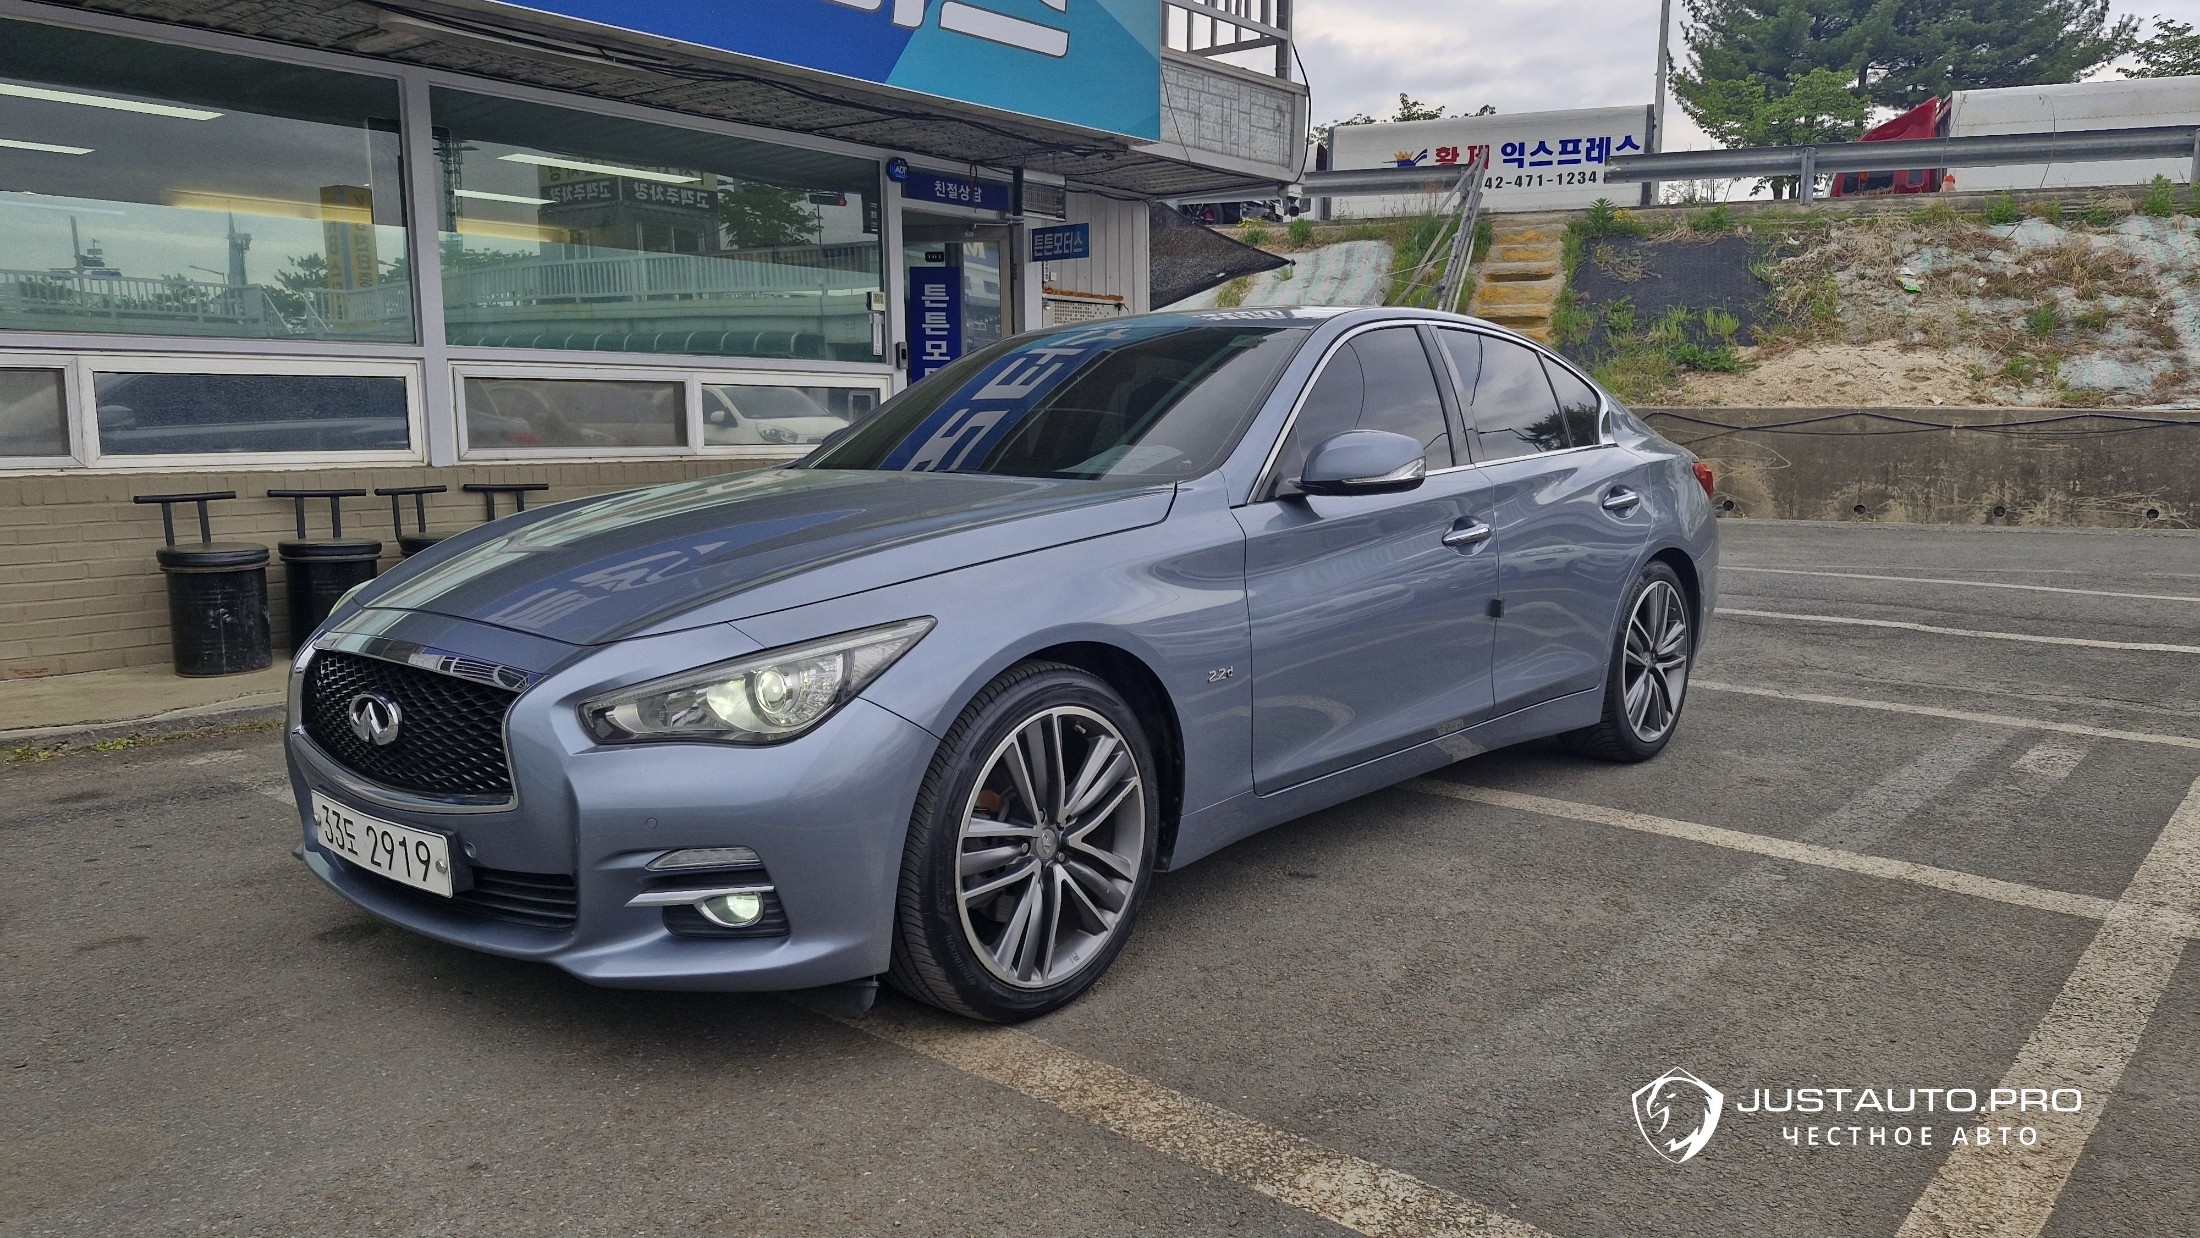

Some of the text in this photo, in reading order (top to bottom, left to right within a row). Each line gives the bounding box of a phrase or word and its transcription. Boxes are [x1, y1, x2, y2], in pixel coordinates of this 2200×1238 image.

[894, 165, 907, 177] ADT
[1484, 170, 1598, 190] 42-471-1234
[934, 180, 983, 203] 친절상담
[1033, 230, 1083, 257] 튼튼모터스
[921, 283, 951, 377] 튼튼모
[321, 804, 431, 882] 33도 2919
